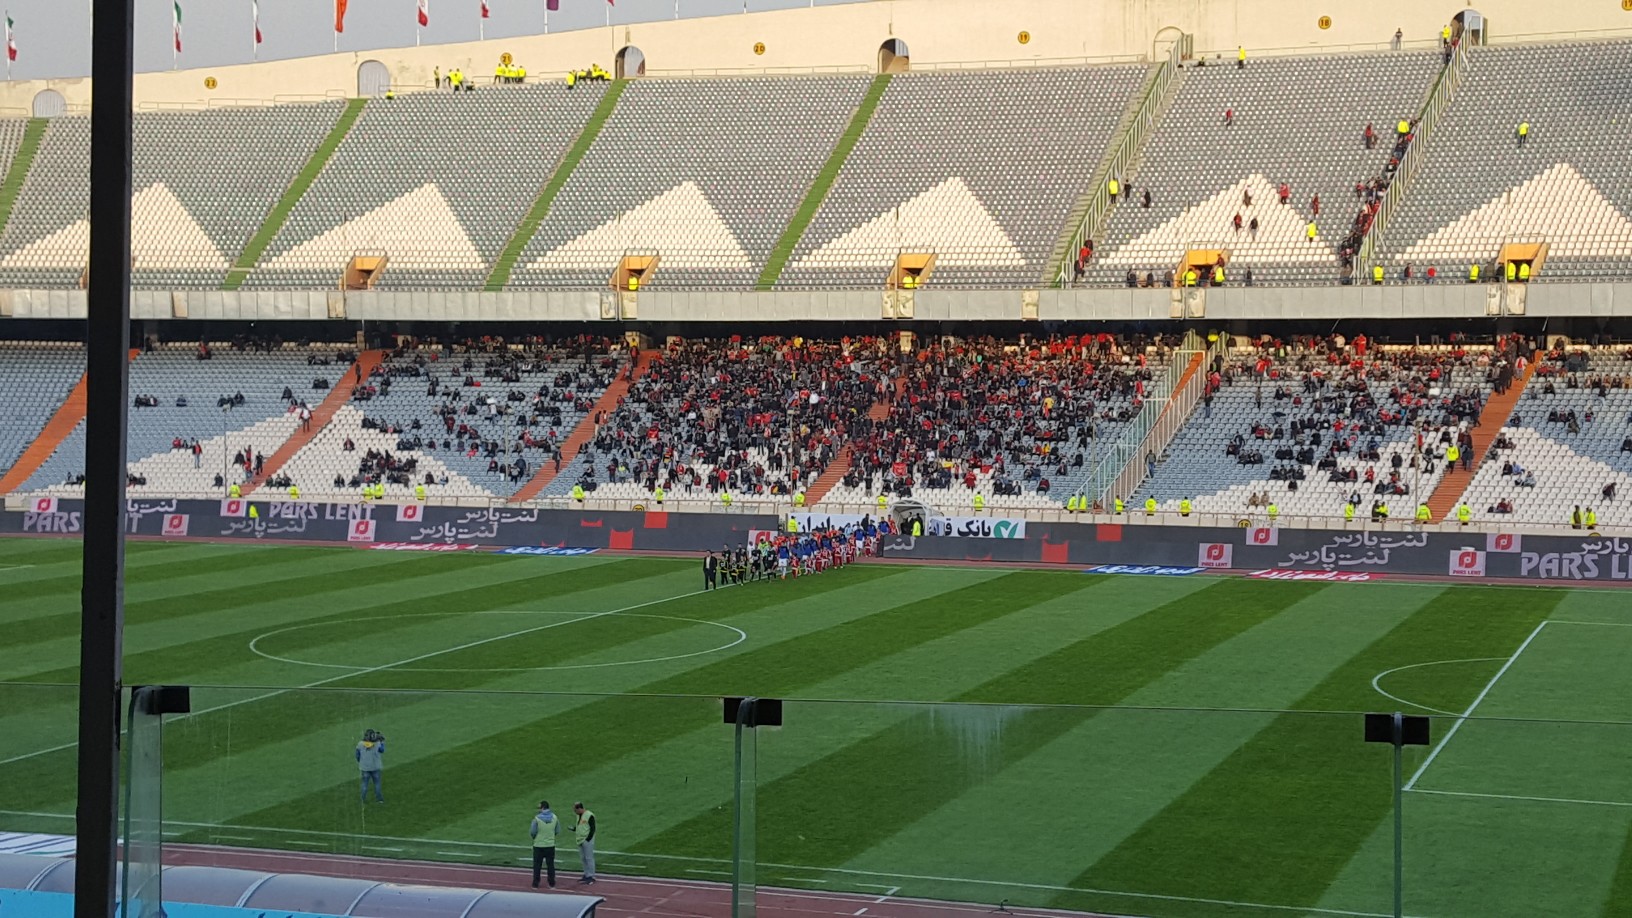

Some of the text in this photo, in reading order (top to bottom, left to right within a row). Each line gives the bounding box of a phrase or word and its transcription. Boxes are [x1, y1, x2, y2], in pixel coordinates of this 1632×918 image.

[269, 502, 376, 520] PARS LENT
[500, 508, 539, 522] لنت
[23, 511, 81, 533] PARS
[268, 517, 308, 534] لنت
[411, 521, 499, 543] لنت پارس
[1380, 532, 1429, 548] لنت
[1278, 546, 1391, 570] لنت پارس
[1521, 551, 1600, 580] PARS
